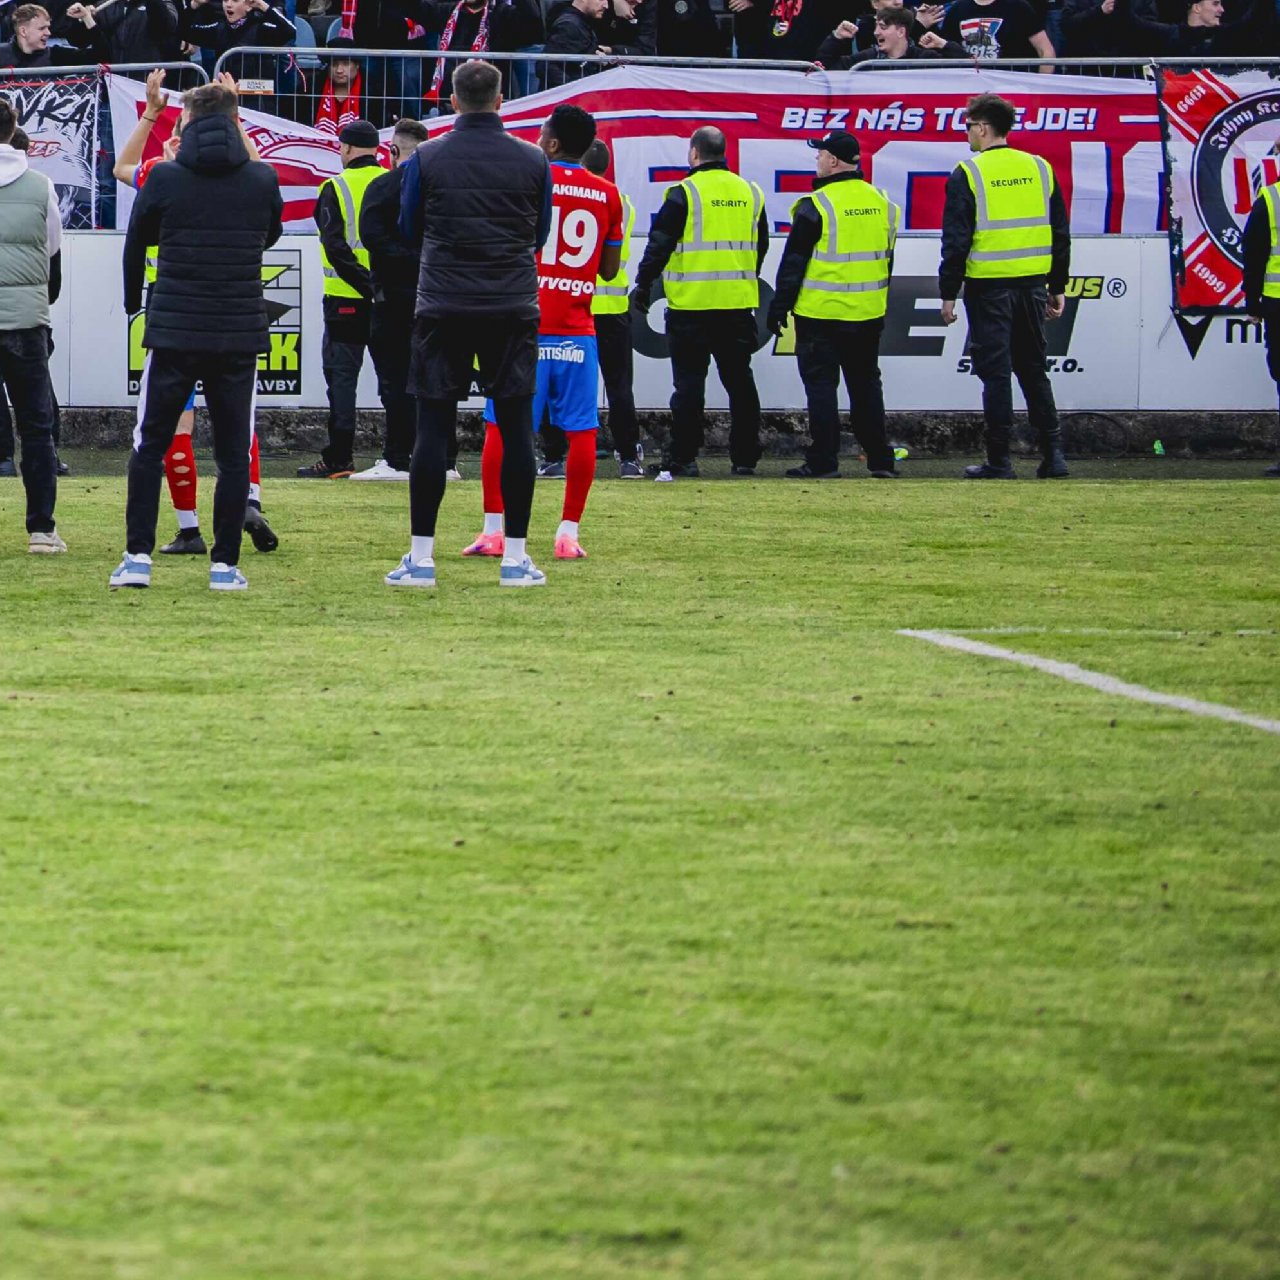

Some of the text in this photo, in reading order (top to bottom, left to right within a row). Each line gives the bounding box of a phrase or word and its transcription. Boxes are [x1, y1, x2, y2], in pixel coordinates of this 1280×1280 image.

[781, 107, 848, 131] BEZ
[854, 100, 925, 132] NÁS
[1010, 107, 1098, 132] EJDE!
[990, 177, 1034, 188] SECURITY
[844, 207, 882, 218] SECURITY
[541, 205, 599, 268] 19
